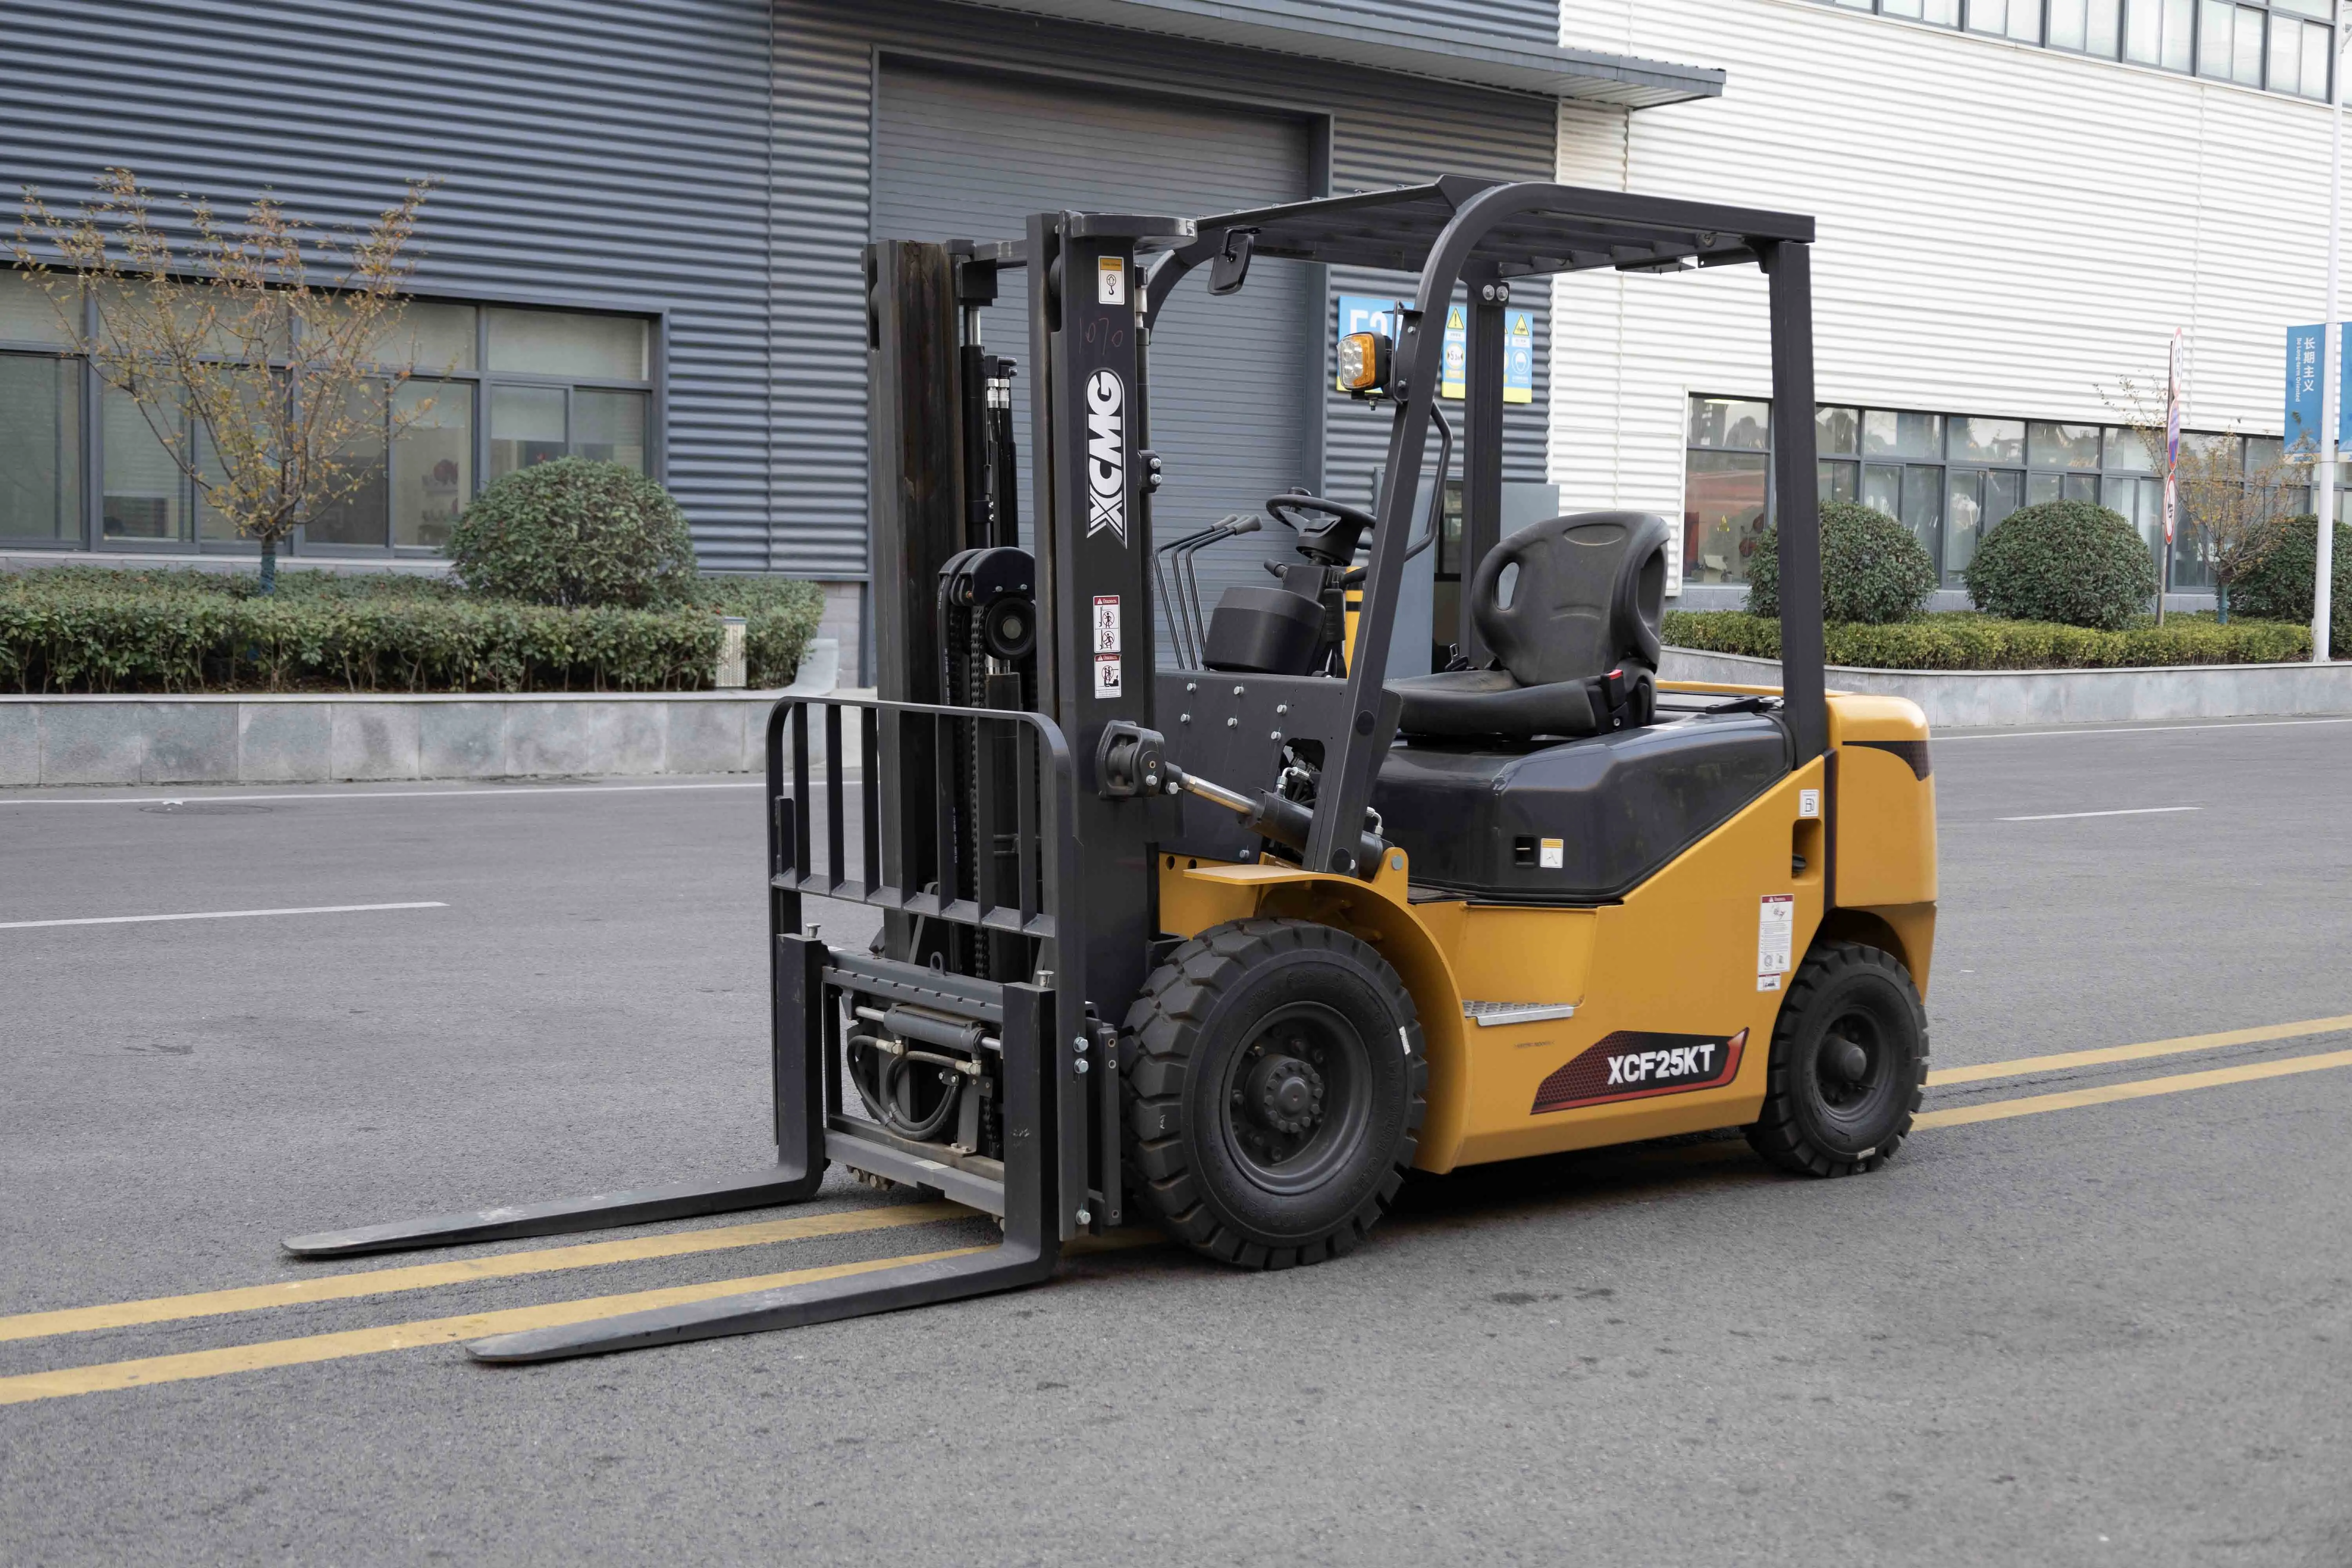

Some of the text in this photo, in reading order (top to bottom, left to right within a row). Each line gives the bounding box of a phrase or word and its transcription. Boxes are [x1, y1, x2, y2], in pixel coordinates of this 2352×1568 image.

[1079, 317, 1123, 355] 1070
[2303, 337, 2316, 392] 长期主义
[1087, 371, 1123, 537] XCMG
[1607, 1044, 1715, 1085] XCF25KT
